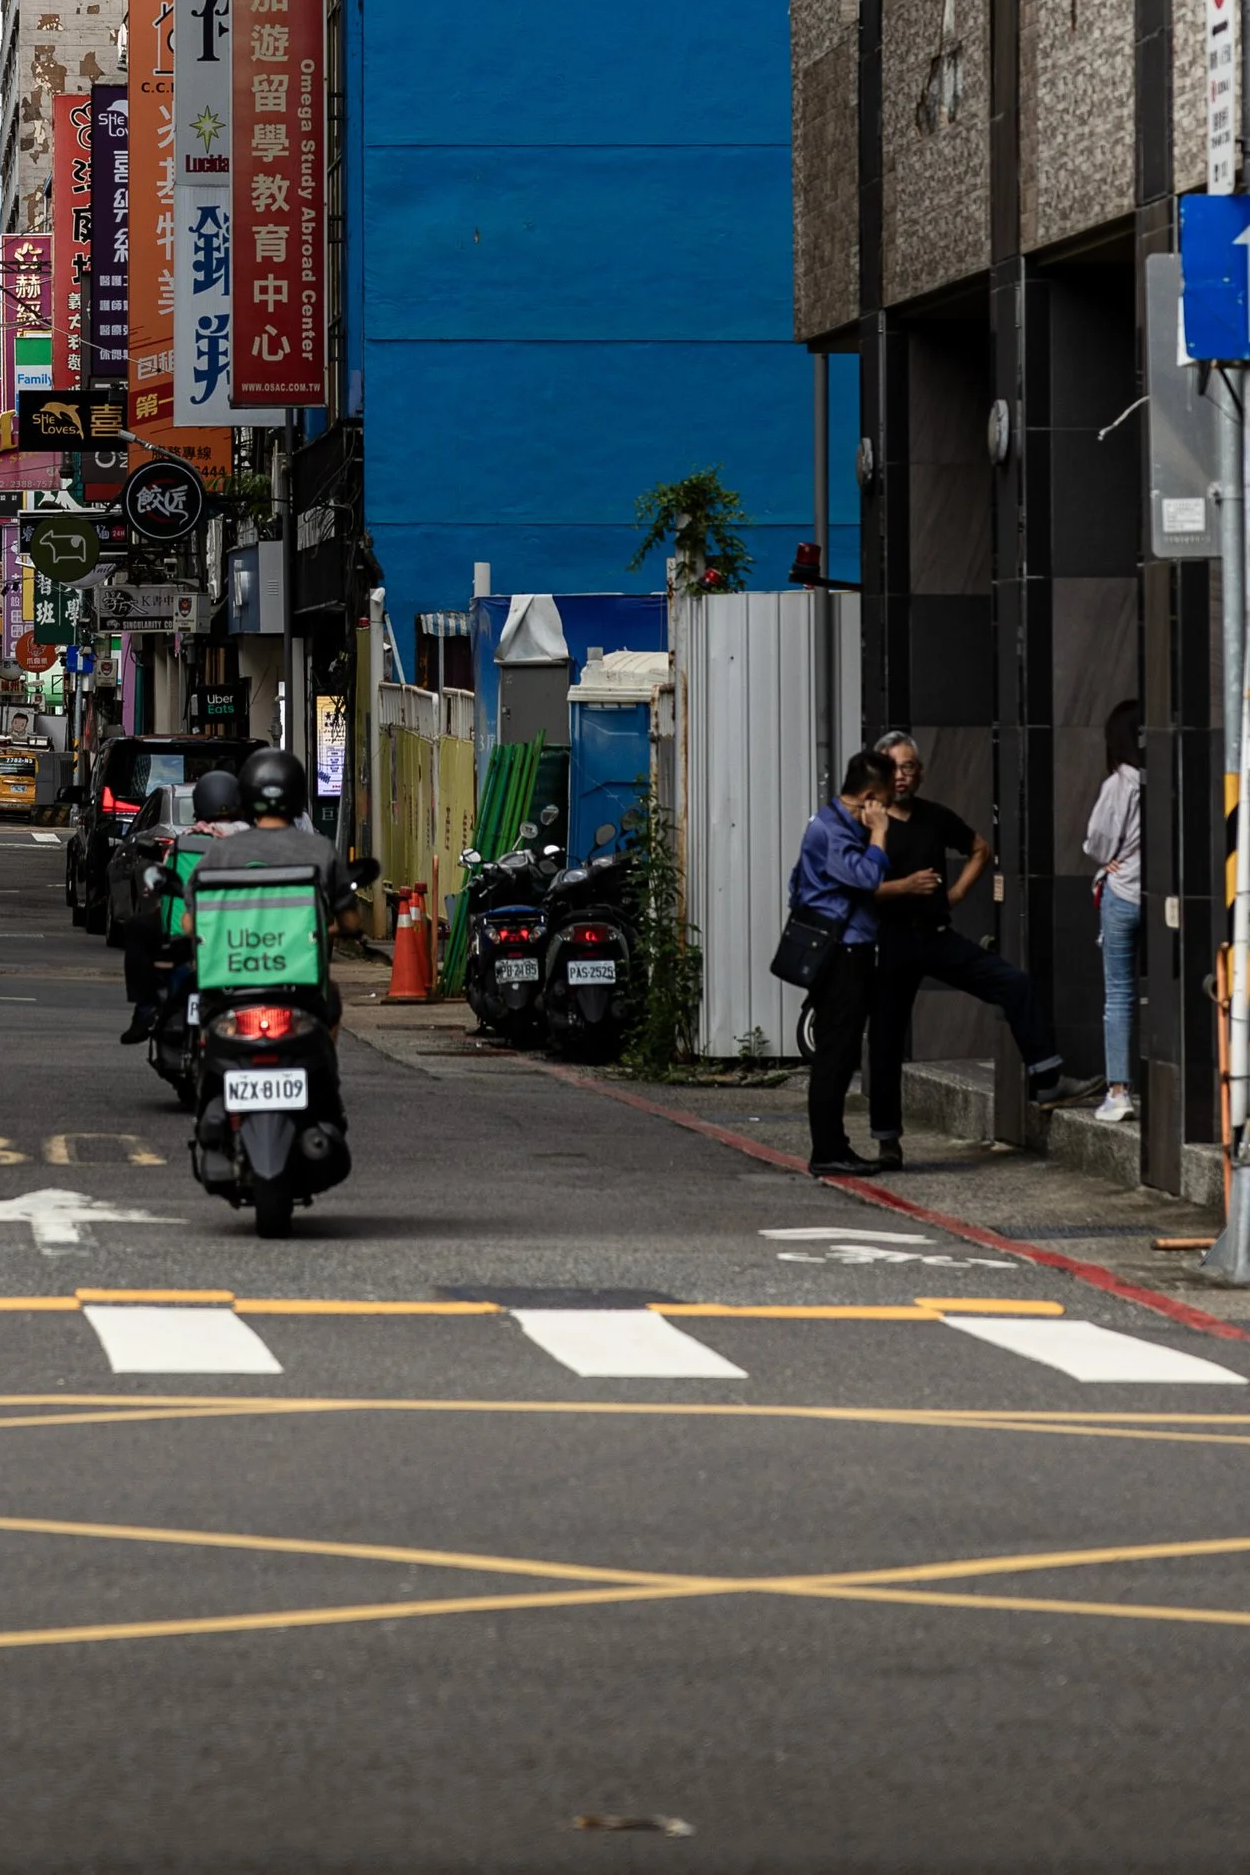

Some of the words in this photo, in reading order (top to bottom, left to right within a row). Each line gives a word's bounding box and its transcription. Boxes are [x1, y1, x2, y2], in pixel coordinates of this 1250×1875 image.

[298, 58, 316, 133] Omega
[298, 139, 317, 201] Study
[301, 206, 317, 282] Abroad
[301, 289, 317, 362] Center
[241, 381, 321, 393] WWW.OSAC.COM.TW
[135, 484, 190, 526] 餃匠
[206, 693, 234, 705] Uber
[207, 704, 235, 715] Eats
[226, 928, 284, 949] Uber
[227, 951, 287, 974] Eats
[228, 1078, 305, 1103] NZX-8109
